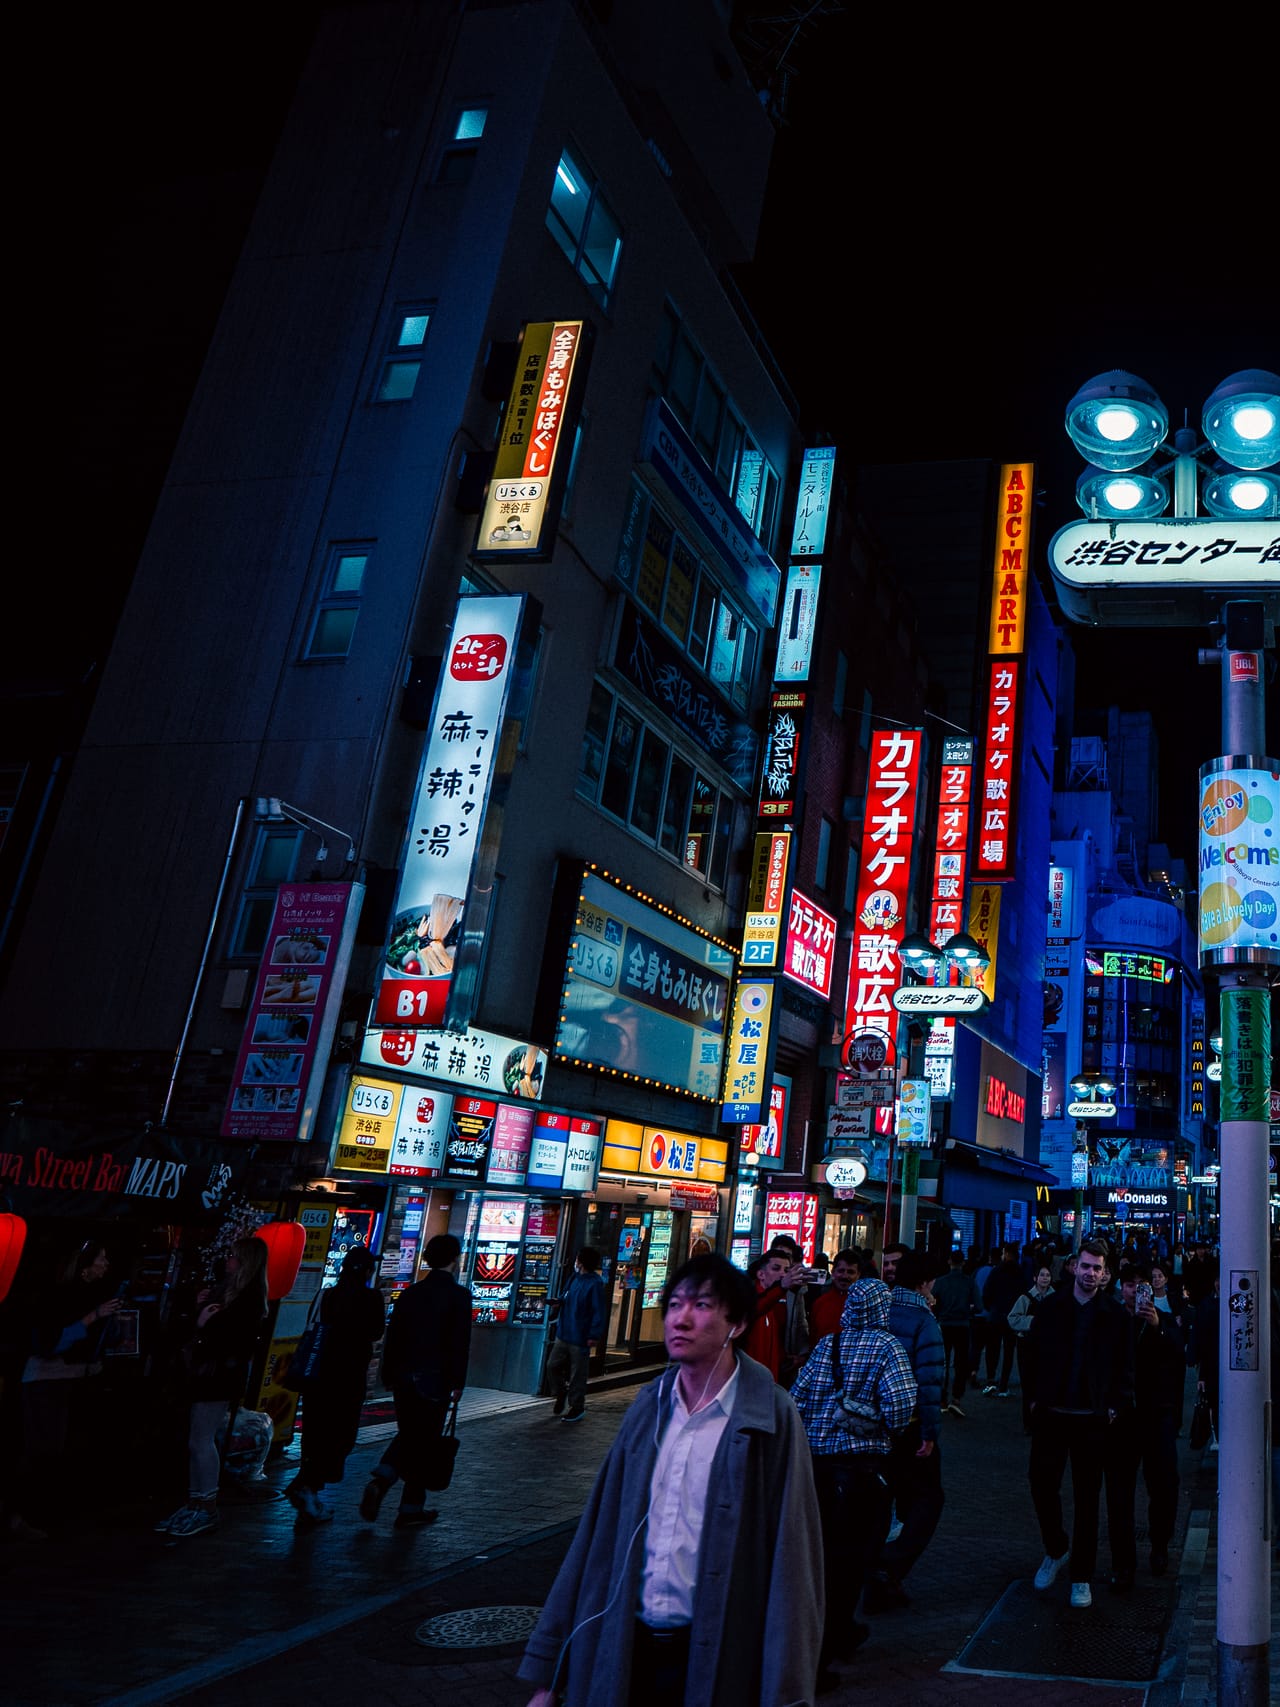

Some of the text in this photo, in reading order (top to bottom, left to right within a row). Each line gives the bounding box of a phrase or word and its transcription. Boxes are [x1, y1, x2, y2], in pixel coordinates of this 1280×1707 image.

[528, 330, 575, 473] 全身もみほぐし
[500, 486, 537, 498] りらくる
[797, 463, 818, 541] モニタールーム
[799, 545, 815, 554] 5F
[456, 638, 503, 677] 北斗
[790, 660, 808, 672] 4F
[989, 670, 1018, 769] カラオケ
[416, 710, 473, 858] 麻辣湯
[459, 728, 490, 836] マーラータン
[762, 803, 790, 814] 3F
[866, 732, 914, 886] カラオケ
[943, 767, 966, 847] カラオケ
[983, 779, 1007, 862] 歌広場
[1202, 791, 1244, 831] Enjoy
[767, 839, 784, 909] 全身もみほぐし
[1200, 845, 1279, 873] Welcome
[1232, 863, 1252, 881] Shibuya
[750, 916, 776, 926] りらくる
[789, 899, 834, 954] カラオケ
[935, 878, 959, 946] 歌広場
[1222, 897, 1253, 923] Lovely
[1254, 900, 1274, 917] Day!
[576, 941, 614, 979] りらくる
[748, 945, 772, 960] 2F
[791, 940, 827, 988] 歌広場
[626, 942, 723, 1022] 全身もみほぐし
[851, 934, 898, 1042] 歌広場
[897, 994, 980, 1005] 渋谷センター街
[396, 990, 428, 1017] B1
[738, 1017, 763, 1065] 松屋
[851, 1044, 883, 1062] 消火栓
[421, 1041, 492, 1083] 麻辣湯
[356, 1090, 389, 1111] りらくる
[985, 1075, 1026, 1124] ABC-MART
[397, 1137, 441, 1158] 麻辣湯
[568, 1148, 596, 1162] メトロビル
[667, 1140, 697, 1171] 松屋
[27, 1146, 188, 1200] Street Bar MAPS
[768, 1196, 801, 1211] カラオケ
[1108, 1191, 1168, 1205] McDonald's
[768, 1212, 800, 1226] 歌広場
